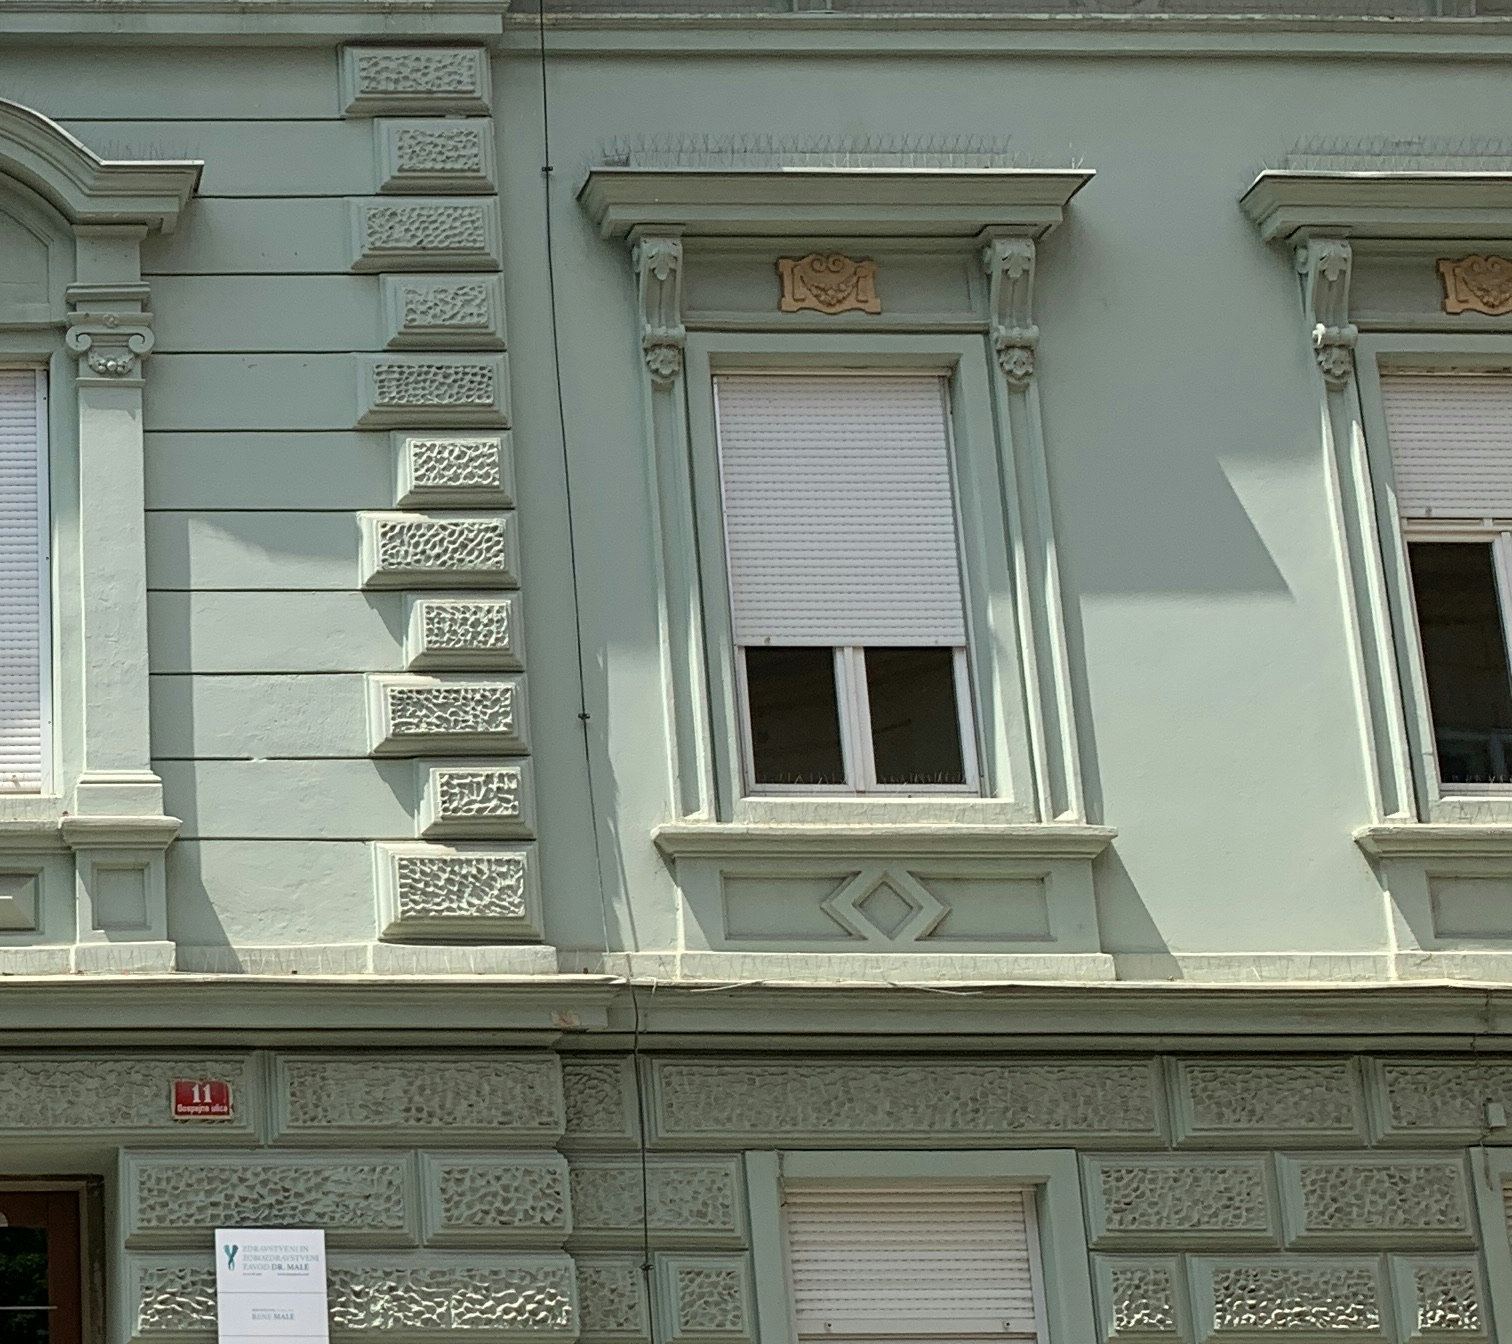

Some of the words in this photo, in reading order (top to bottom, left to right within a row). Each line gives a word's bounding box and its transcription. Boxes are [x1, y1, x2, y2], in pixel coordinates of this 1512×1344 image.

[192, 1084, 212, 1103] 11
[211, 1104, 228, 1112] ulica
[242, 1263, 270, 1271] ZAVOD
[271, 1263, 285, 1271] DR.
[286, 1263, 309, 1271] MALE
